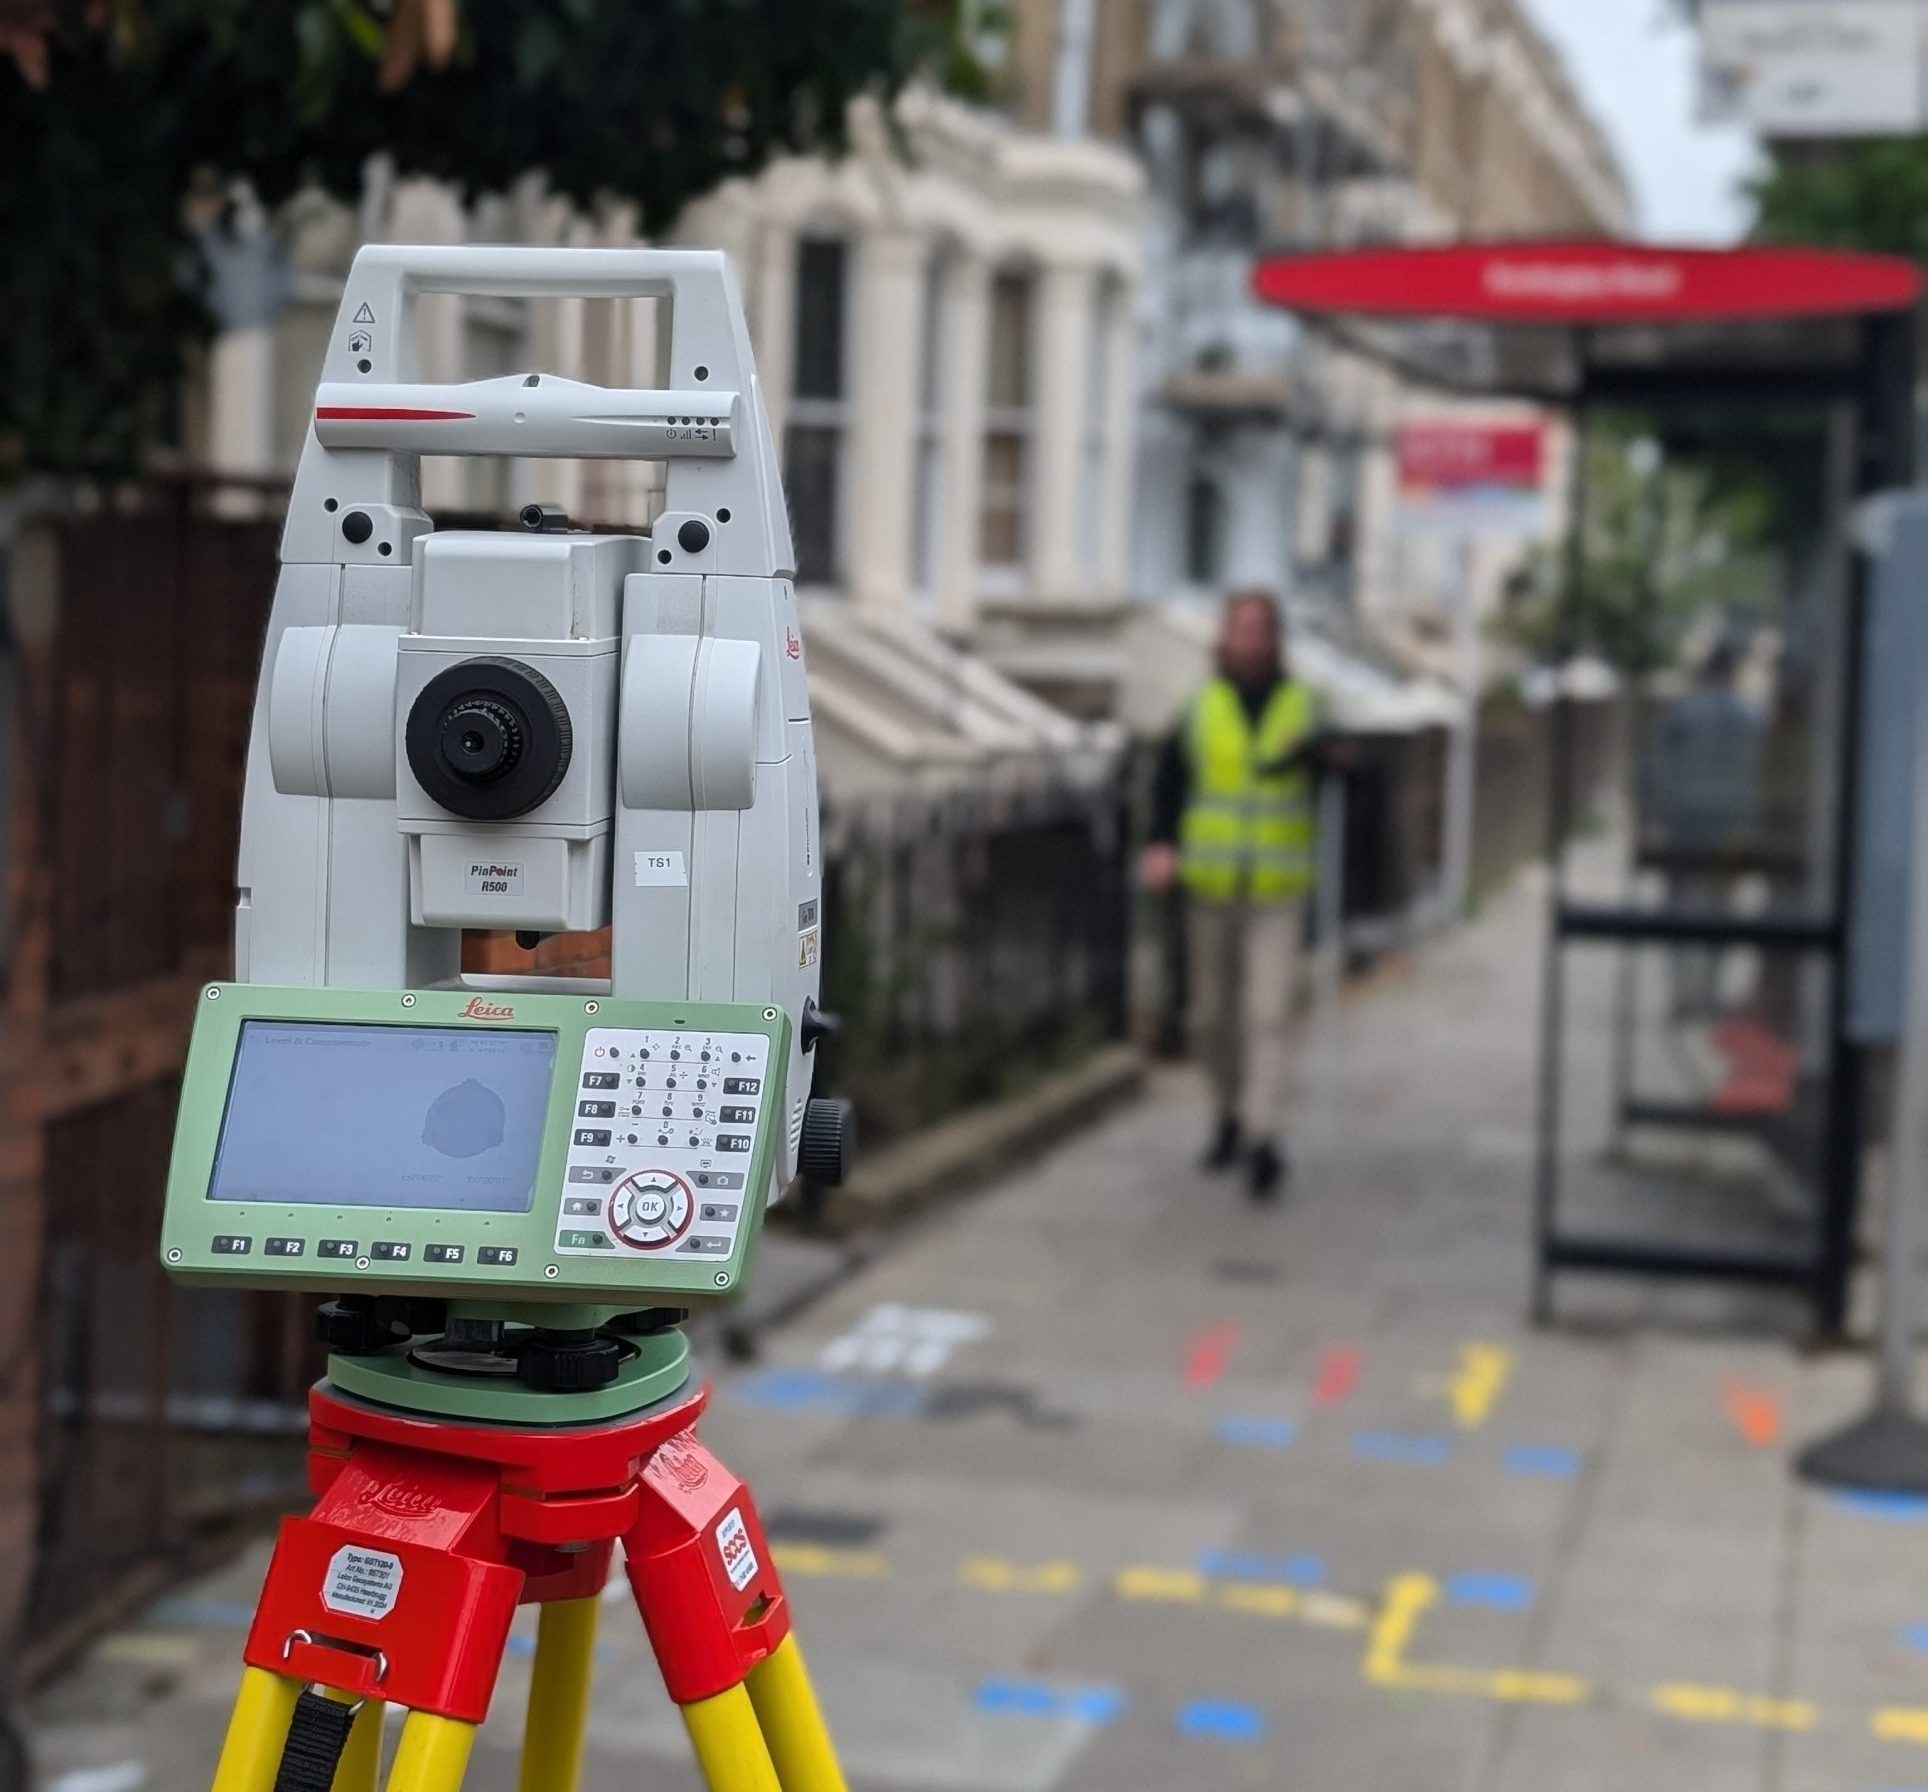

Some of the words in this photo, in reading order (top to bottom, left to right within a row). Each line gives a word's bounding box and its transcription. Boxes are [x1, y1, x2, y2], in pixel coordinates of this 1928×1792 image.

[647, 857, 671, 868] TS1
[470, 865, 518, 877] PinPoint
[481, 881, 508, 892] R500
[457, 996, 515, 1021] Leica
[644, 1035, 649, 1043] 1
[674, 1036, 681, 1045] 2
[705, 1037, 711, 1046] 3
[639, 1063, 645, 1072] 4
[671, 1064, 677, 1073] 5
[701, 1065, 707, 1074] 6
[589, 1076, 602, 1086] F7
[738, 1081, 757, 1092] F12
[637, 1091, 643, 1100] 7
[666, 1092, 673, 1101] 8
[697, 1093, 704, 1102] 9
[584, 1104, 598, 1114] F8
[734, 1110, 753, 1121] F11
[663, 1121, 669, 1129] 0
[580, 1132, 594, 1143] F9
[730, 1138, 750, 1149] F10
[642, 1202, 658, 1212] OK
[571, 1234, 586, 1245] Fn
[232, 1240, 246, 1250] F1
[286, 1242, 300, 1252] F2
[339, 1244, 353, 1255] F3
[393, 1246, 407, 1257] F4
[446, 1248, 459, 1259] F5
[499, 1250, 513, 1261] F6
